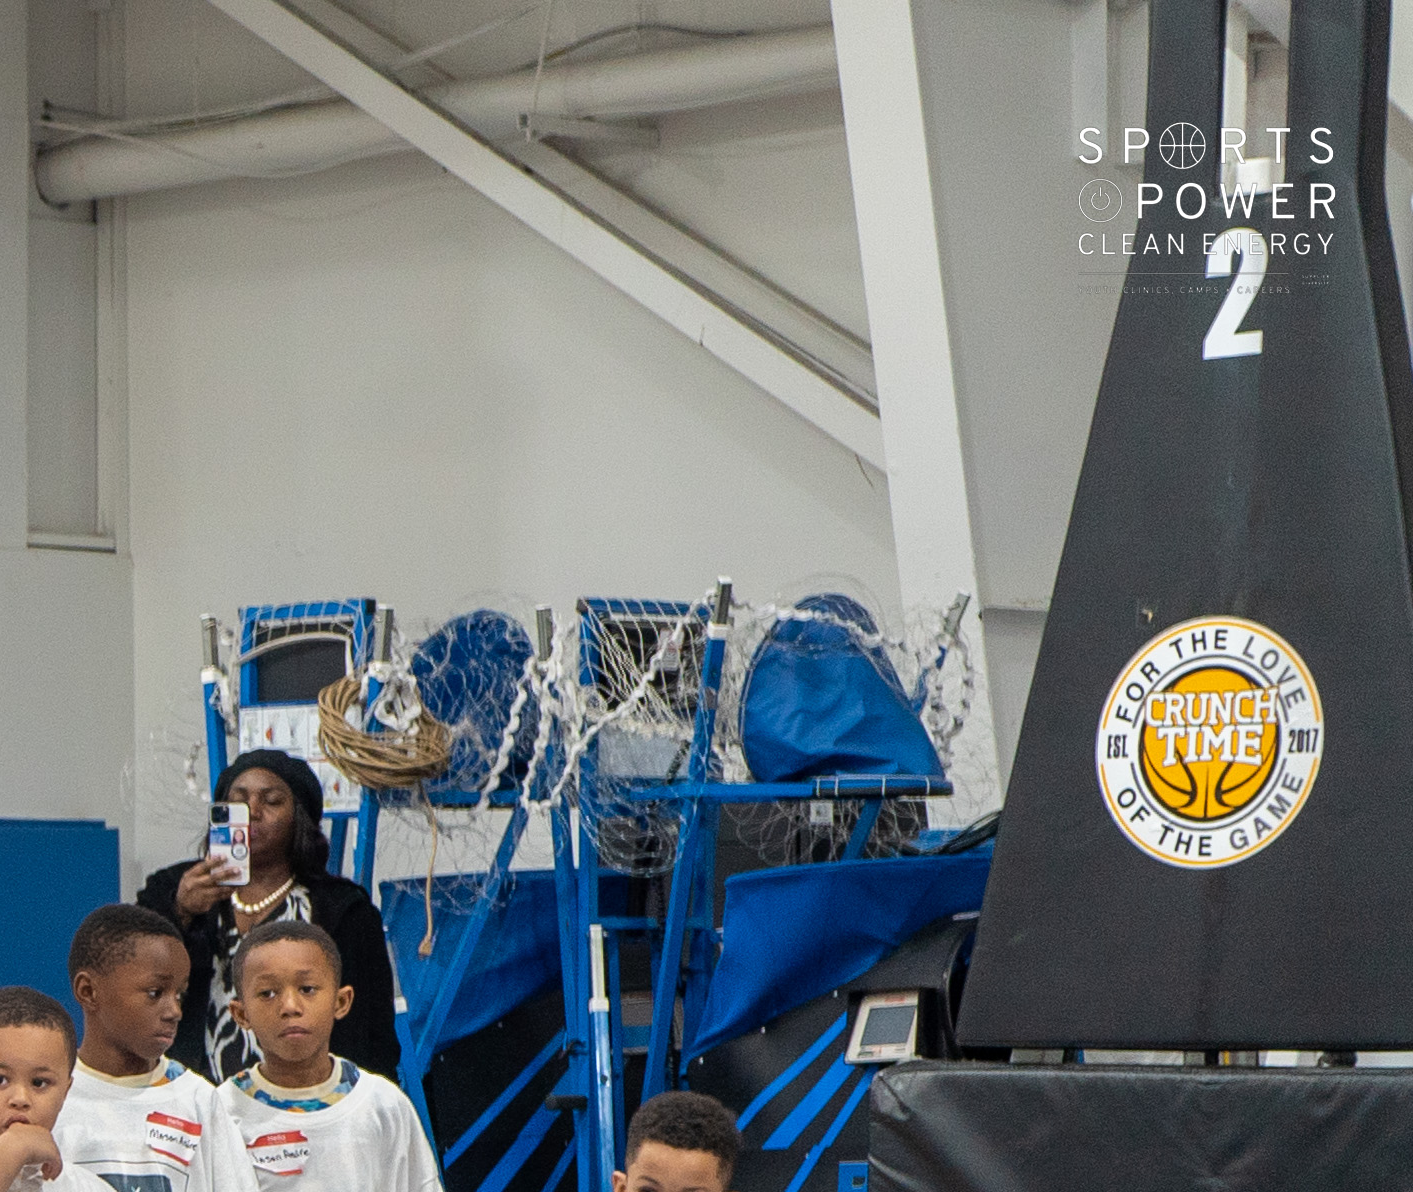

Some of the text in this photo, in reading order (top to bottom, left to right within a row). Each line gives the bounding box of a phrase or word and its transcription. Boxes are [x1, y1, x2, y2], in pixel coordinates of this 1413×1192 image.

[1202, 227, 1268, 361] 2
[1116, 629, 1307, 724] FOR THE LOVE
[1144, 685, 1279, 727] CRUNCH
[1157, 723, 1264, 767] TIME
[1288, 728, 1319, 755] 2017
[1117, 772, 1304, 857] OF THE GAME
